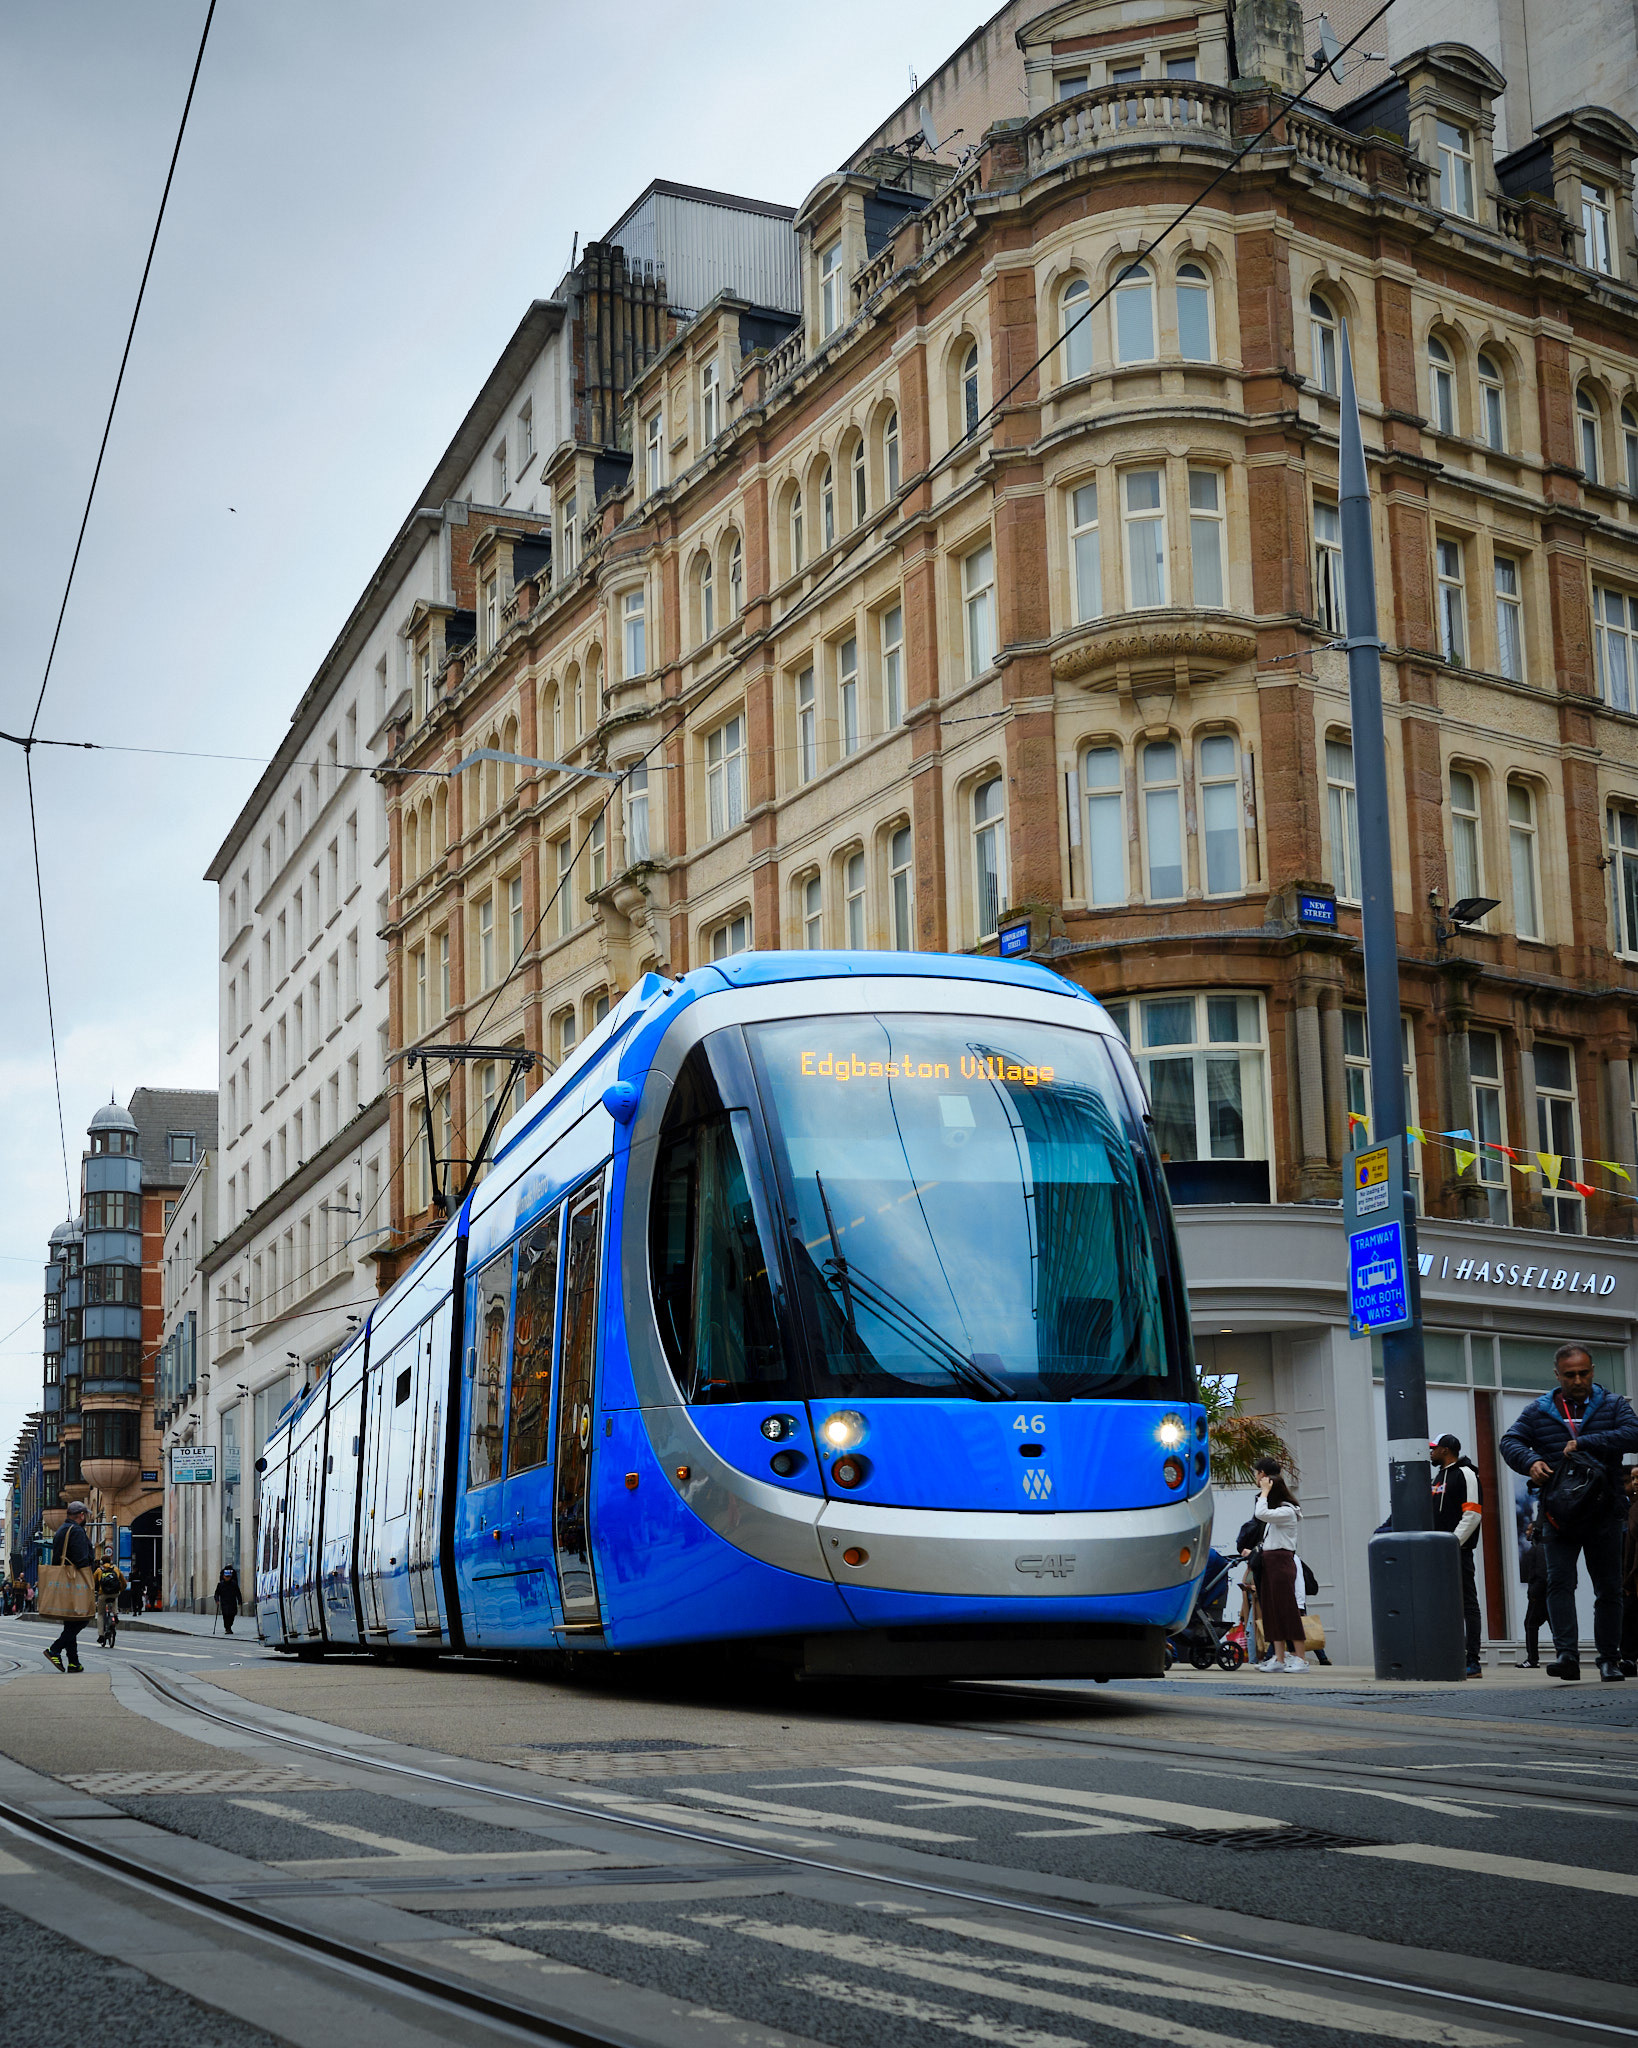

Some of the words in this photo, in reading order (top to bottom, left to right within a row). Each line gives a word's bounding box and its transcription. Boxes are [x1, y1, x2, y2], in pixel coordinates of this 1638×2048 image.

[1304, 909, 1332, 919] STREET
[1309, 901, 1326, 910] NEW
[801, 1051, 950, 1081] Edgbaston
[960, 1056, 1055, 1086] Village
[1355, 1229, 1394, 1251] TRAMWAY
[1455, 1258, 1616, 1296] HASSELBLAD
[1355, 1293, 1377, 1310] LOOK
[1379, 1287, 1402, 1304] BOTH
[1367, 1305, 1391, 1321] WAYS
[1013, 1414, 1046, 1434] 46
[1015, 1554, 1077, 1579] CAF
